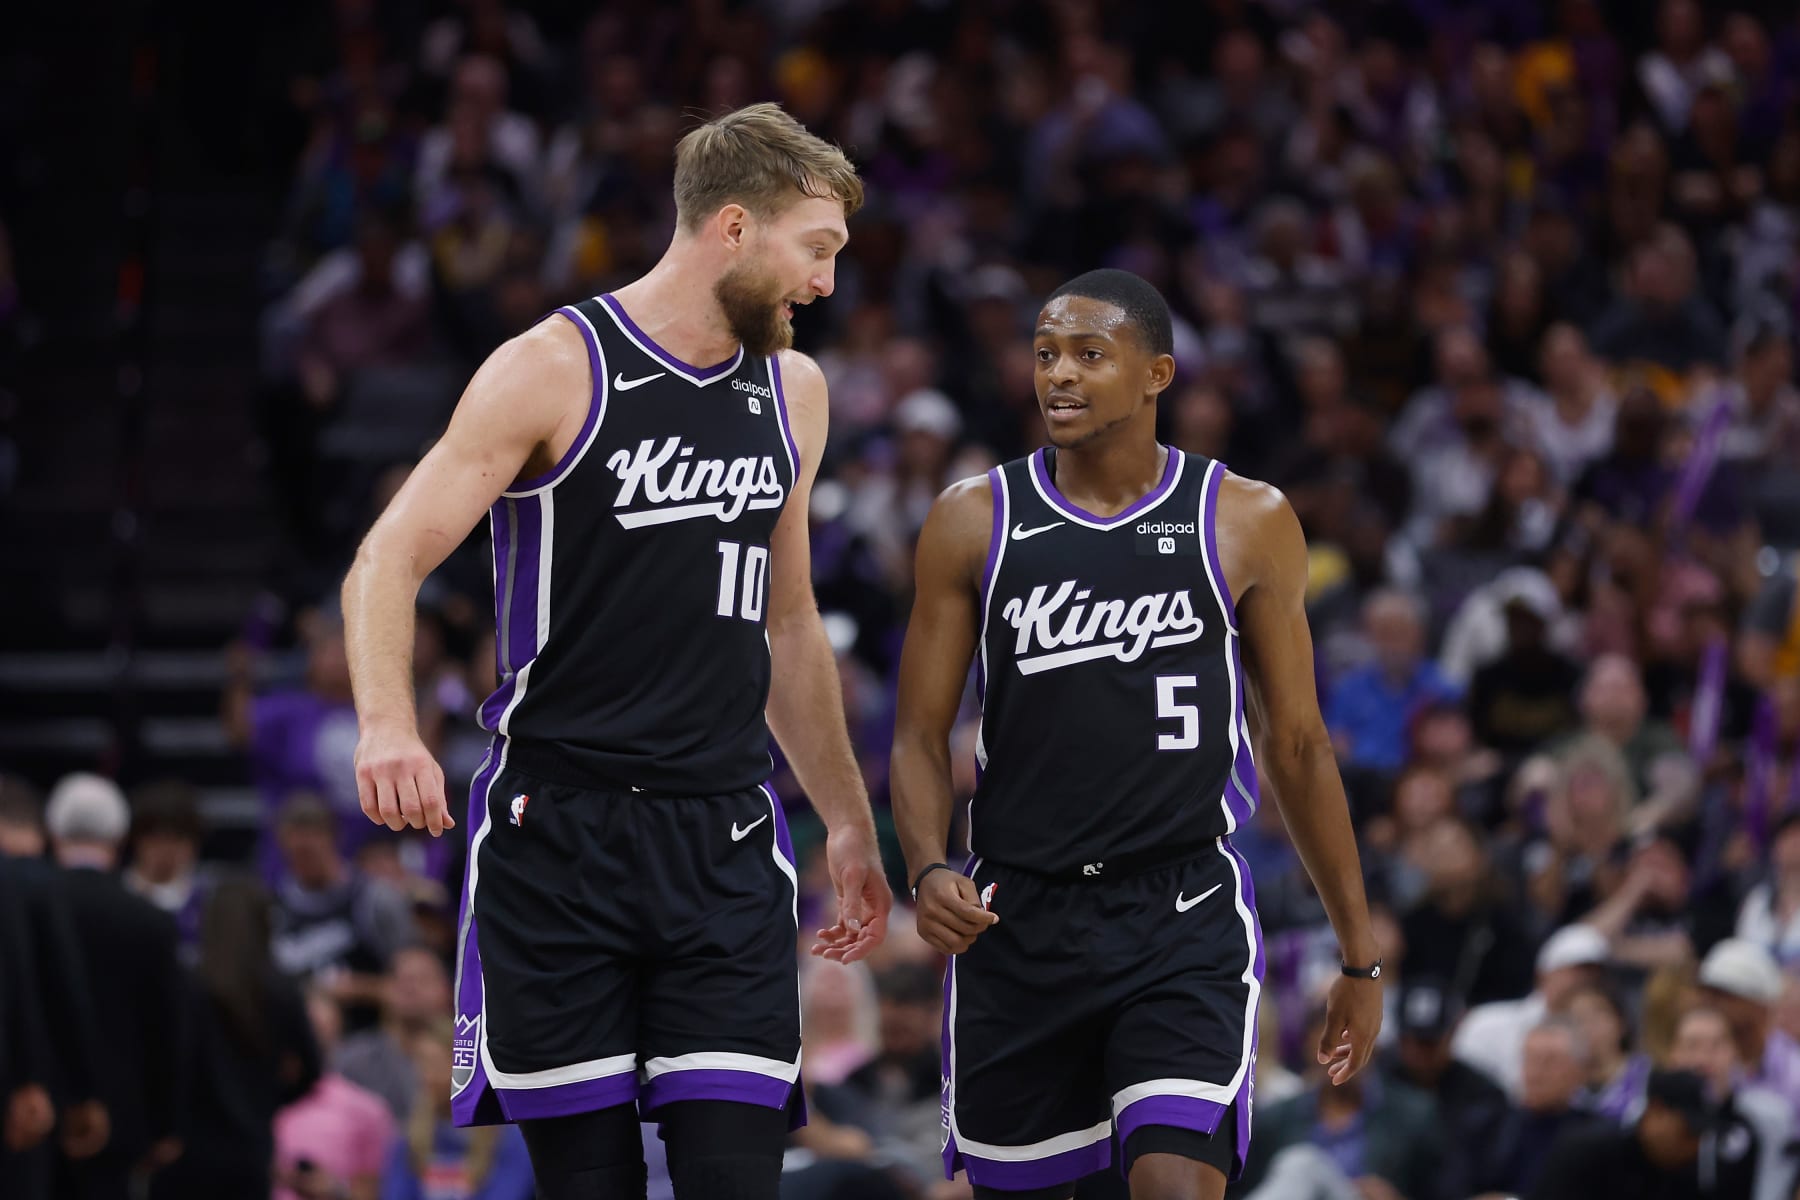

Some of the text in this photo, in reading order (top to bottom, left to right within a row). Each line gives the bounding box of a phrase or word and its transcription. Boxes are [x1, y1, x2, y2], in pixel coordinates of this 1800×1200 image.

[731, 378, 771, 398] dialpad
[606, 436, 784, 530] Kings
[1136, 520, 1195, 536] dialpad
[717, 541, 768, 622] 10
[1002, 579, 1204, 676] Kings
[1156, 675, 1200, 751] 5
